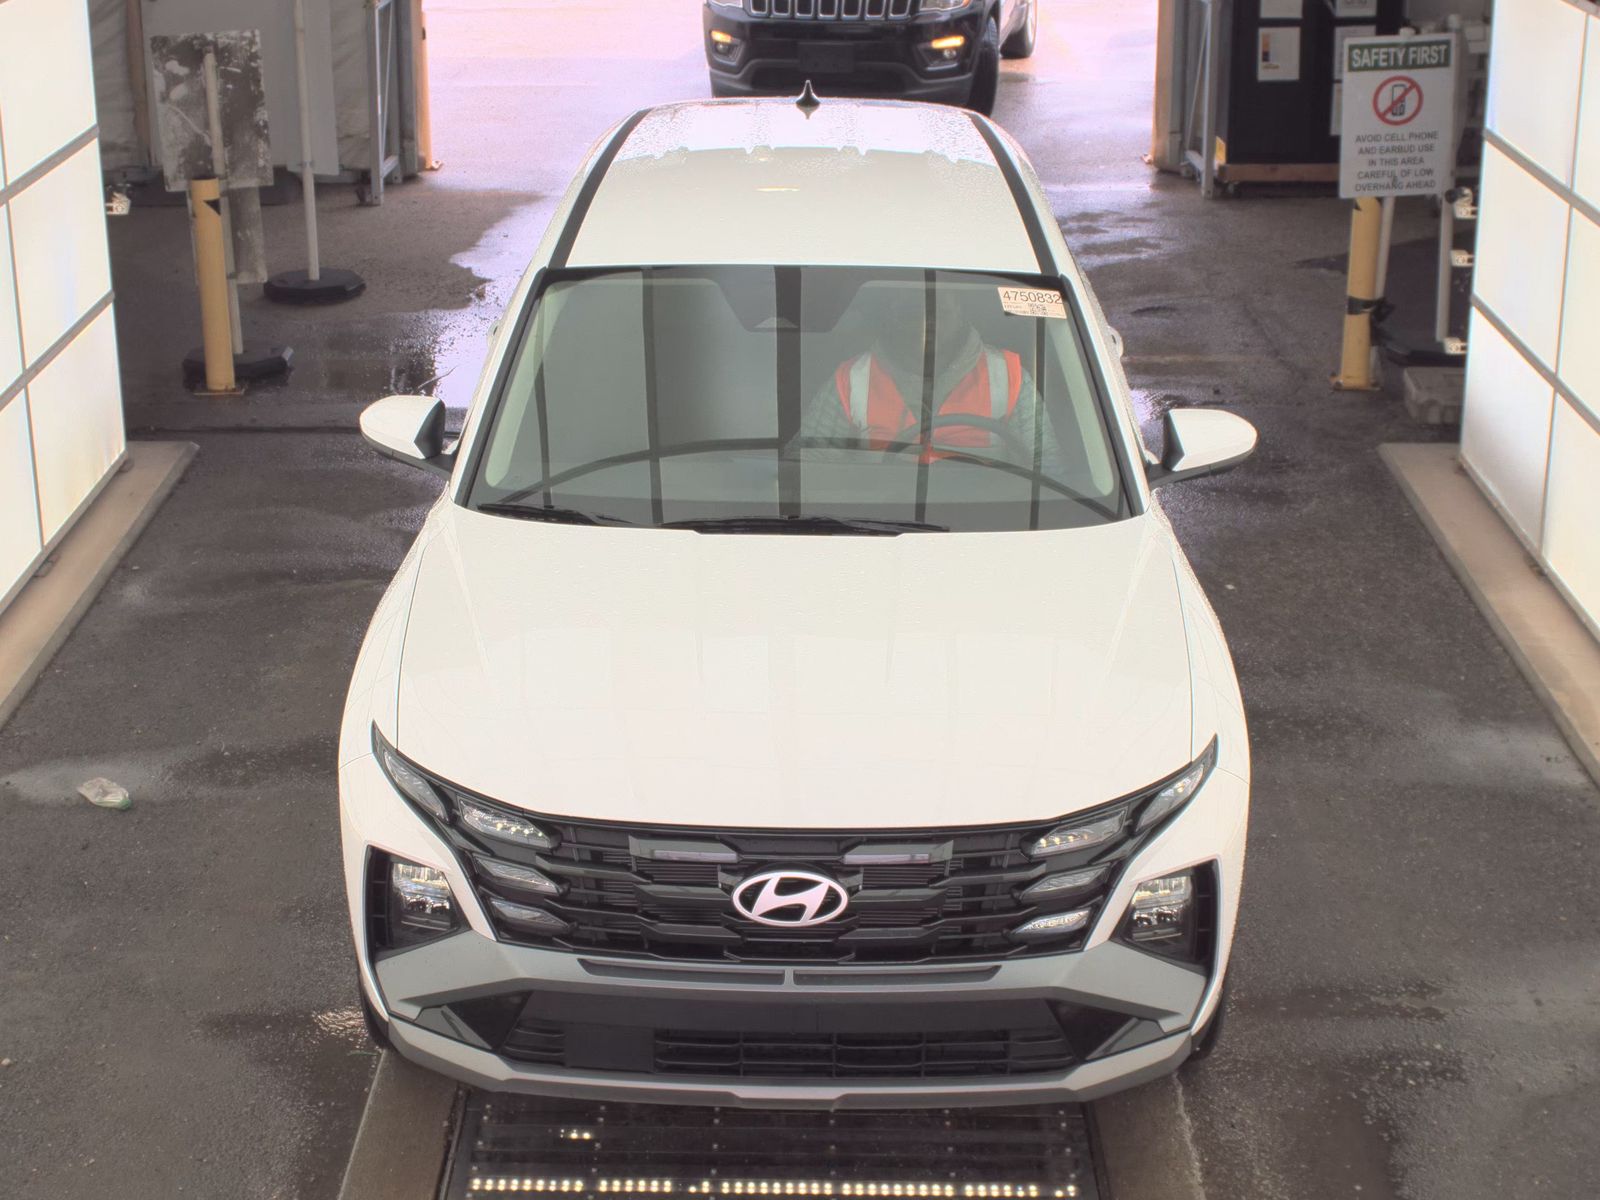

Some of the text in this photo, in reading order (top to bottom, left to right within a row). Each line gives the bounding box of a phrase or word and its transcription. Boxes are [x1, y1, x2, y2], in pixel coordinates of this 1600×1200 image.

[1352, 44, 1448, 68] SAFETY FIRST
[1355, 130, 1439, 143] AVOID CELL PHONE
[1358, 143, 1435, 155] AND EARBUD USE
[1368, 156, 1425, 167] IN THIS AREA
[1357, 168, 1434, 179] CAREFUL OF LOW
[1355, 180, 1436, 192] OVERHANG AHEAD
[1003, 290, 1063, 304] 4750832
